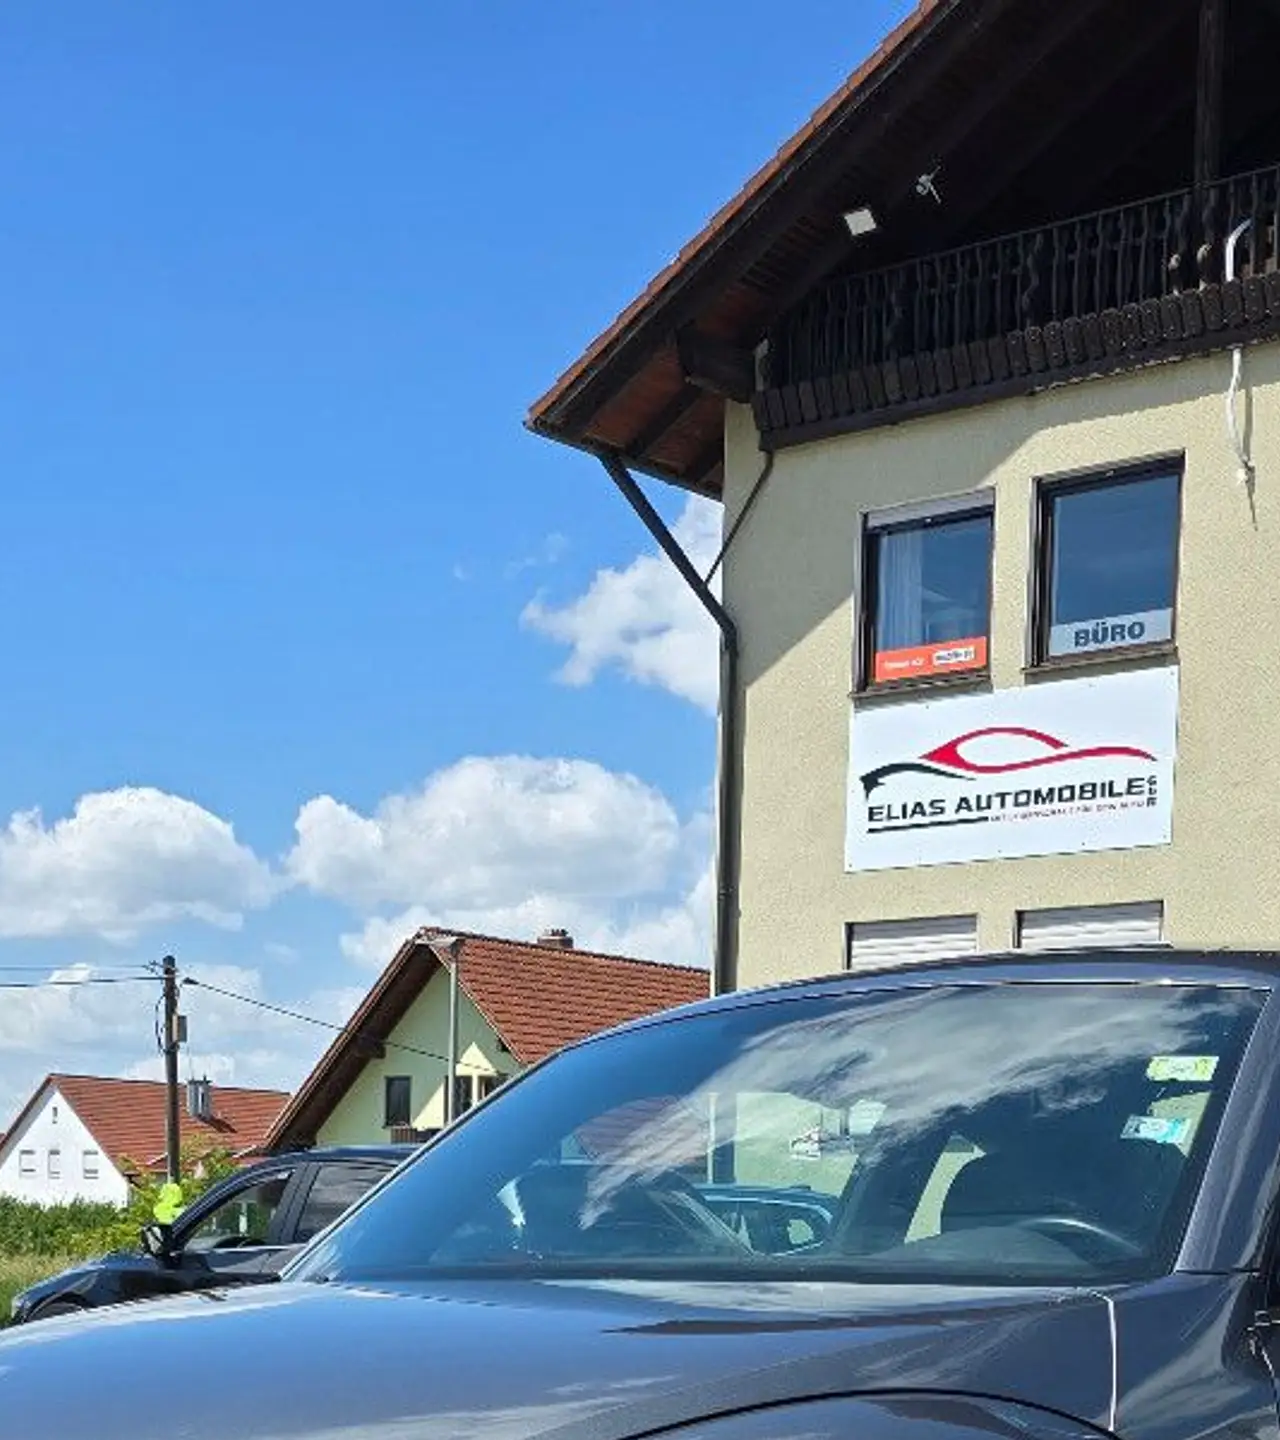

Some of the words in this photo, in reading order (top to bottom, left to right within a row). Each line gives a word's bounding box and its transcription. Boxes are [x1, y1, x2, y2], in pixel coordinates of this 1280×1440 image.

[1074, 621, 1145, 647] BÜRO
[868, 799, 946, 822] ELIAS
[955, 777, 1145, 814] AUTOMOBILE
